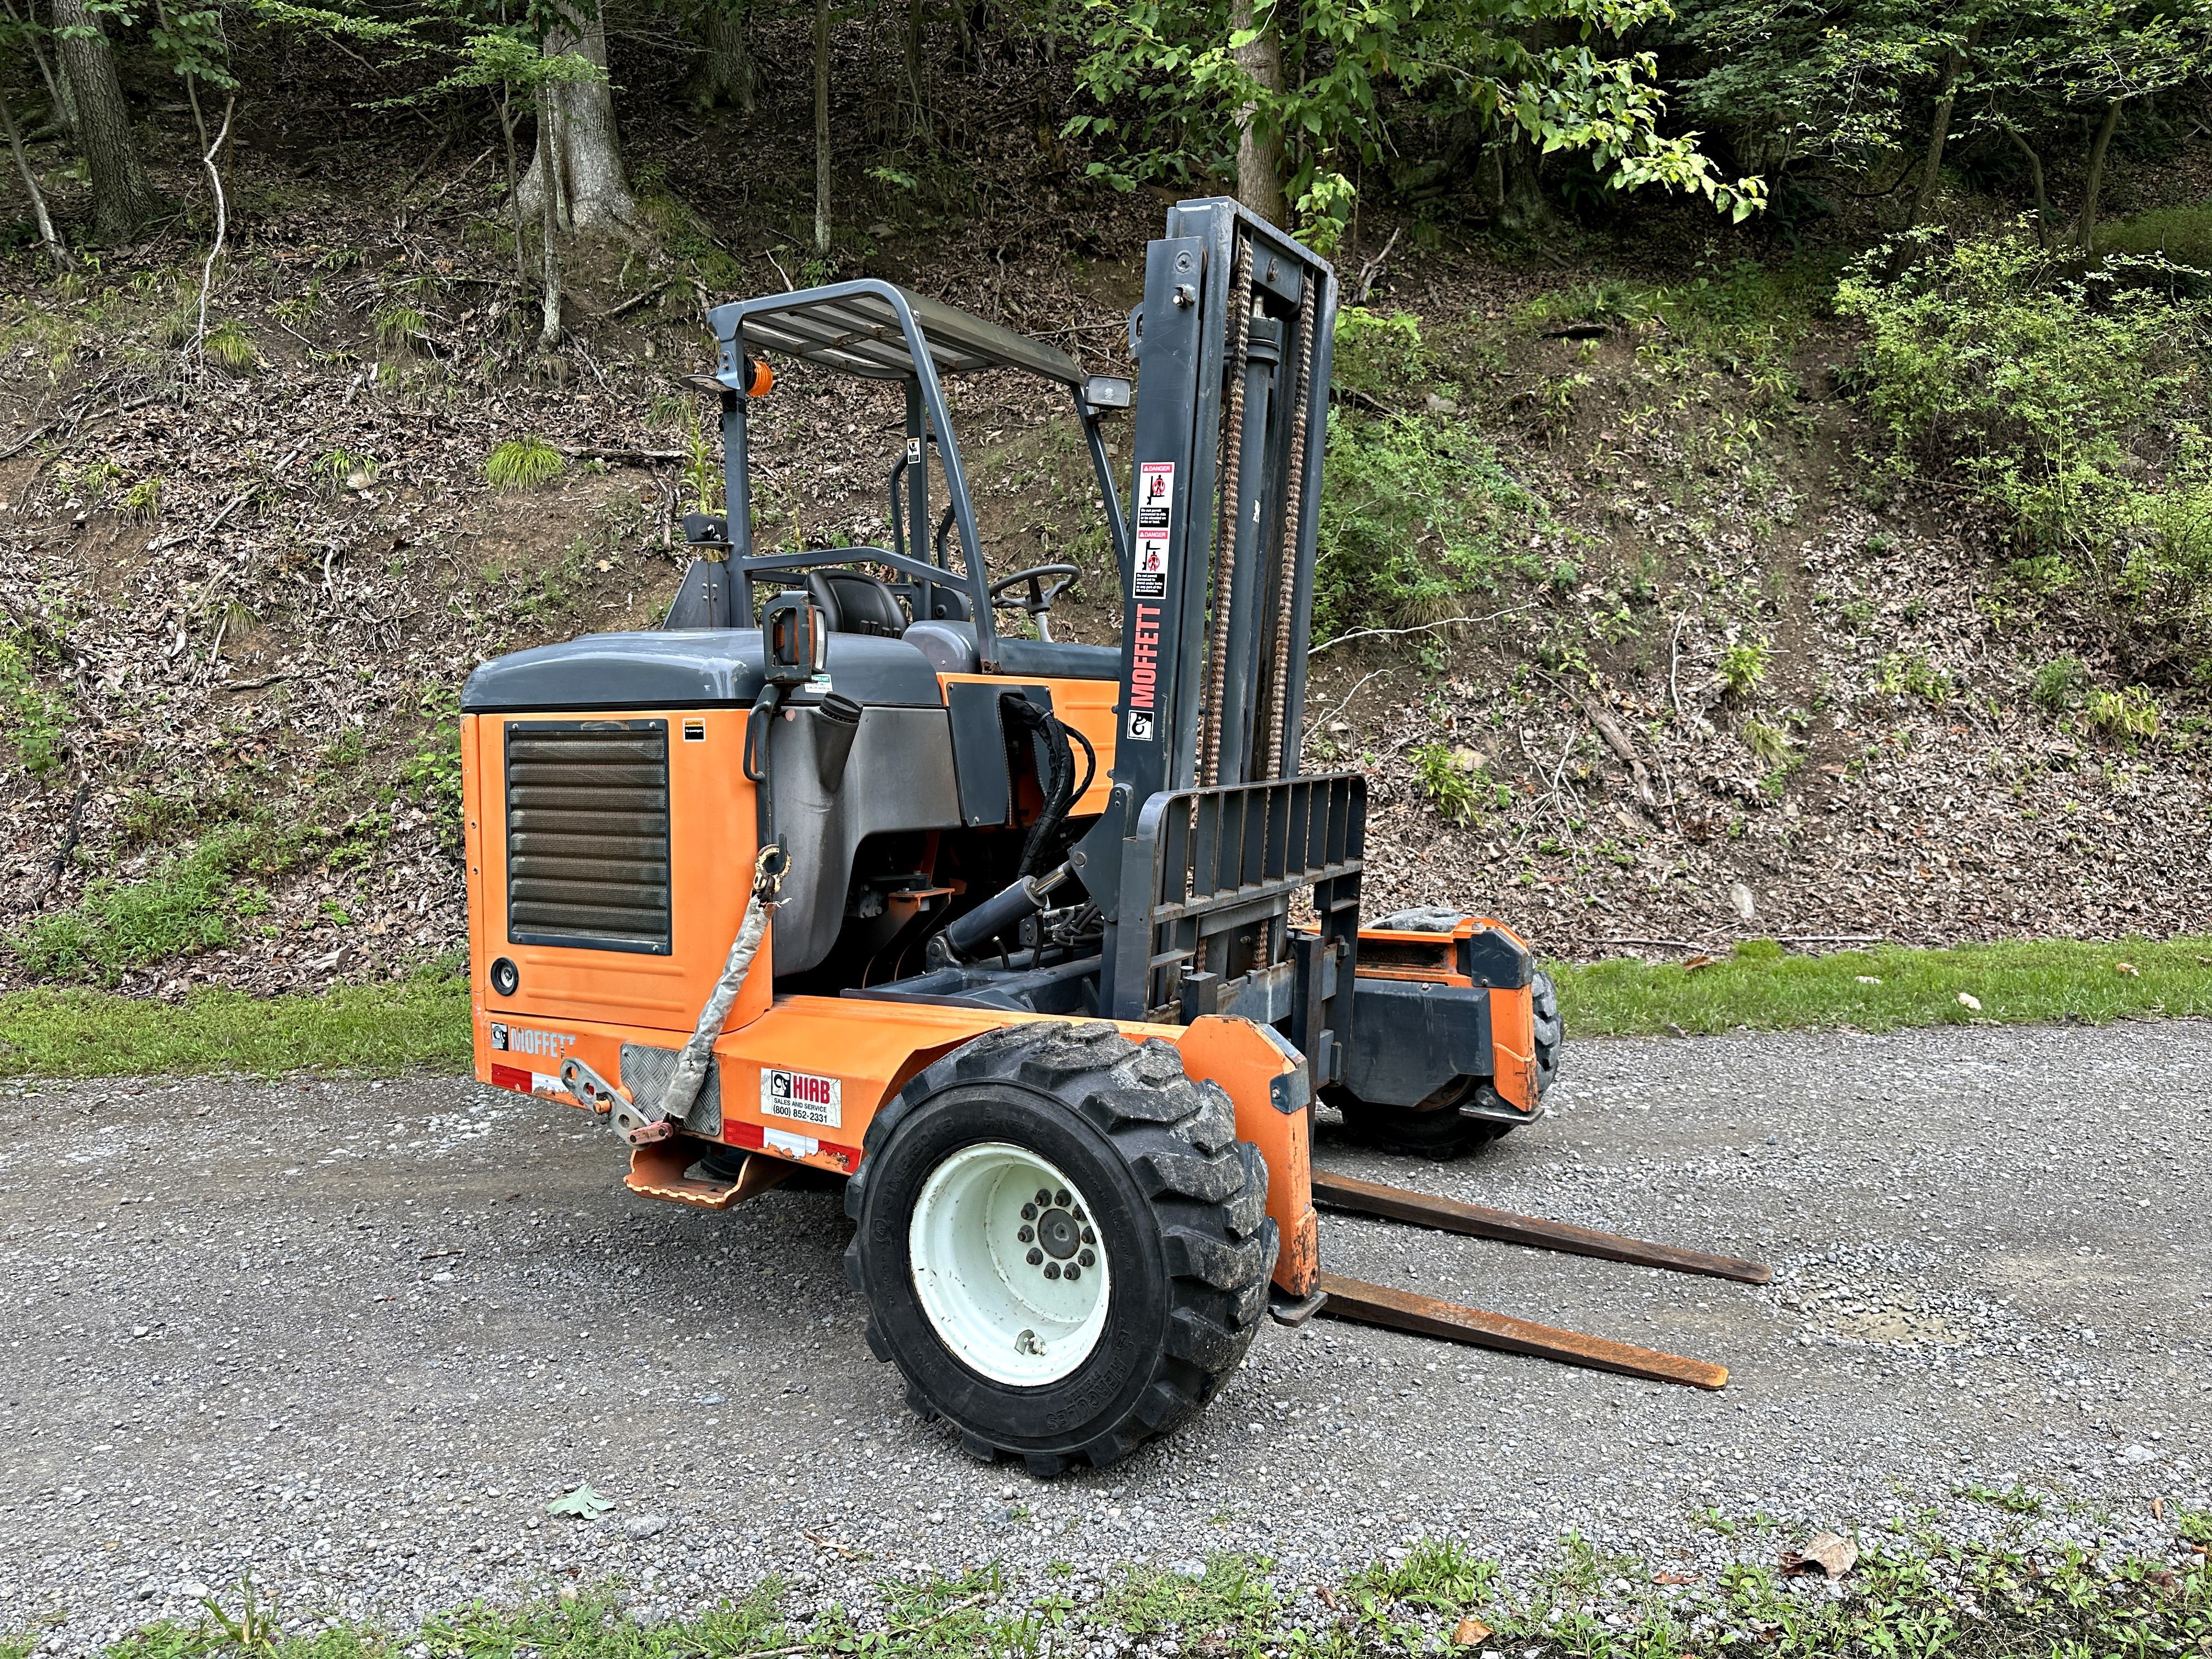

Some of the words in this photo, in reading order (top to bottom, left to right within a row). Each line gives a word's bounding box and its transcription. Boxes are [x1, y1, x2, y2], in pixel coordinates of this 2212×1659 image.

[1131, 603, 1160, 708] MOFFETT
[511, 1026, 575, 1059] MOFFETT
[793, 1075, 830, 1104] HIAB
[774, 1104, 791, 1117] (800)
[793, 1109, 827, 1123] 852-2331
[804, 1103, 827, 1113] SERVICE
[1046, 1357, 1127, 1430] HERCULES
